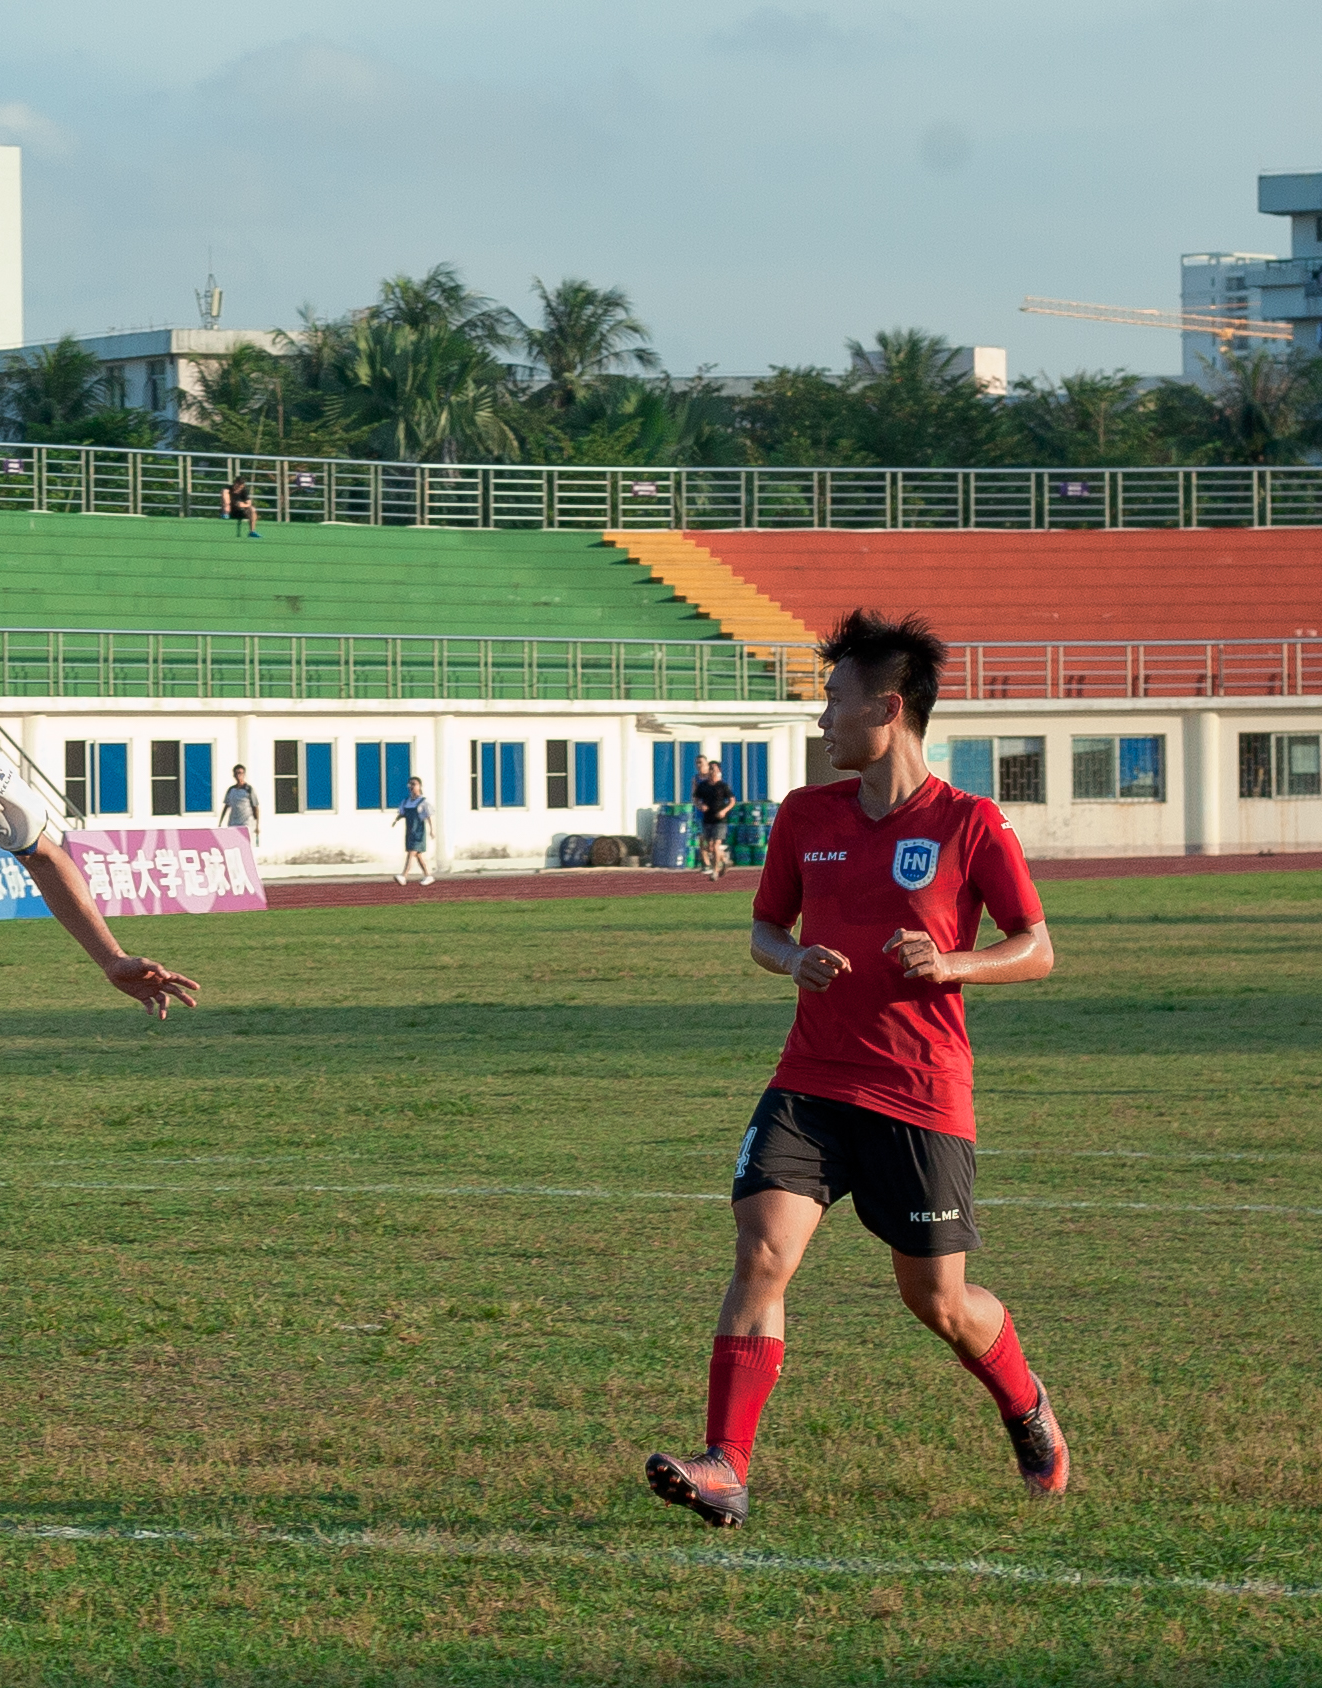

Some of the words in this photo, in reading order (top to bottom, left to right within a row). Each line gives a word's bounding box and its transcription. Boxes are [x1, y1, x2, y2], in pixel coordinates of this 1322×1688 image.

[803, 851, 847, 862] KELME
[82, 848, 255, 901] 海南大学足球队
[910, 1209, 960, 1222] KELME
